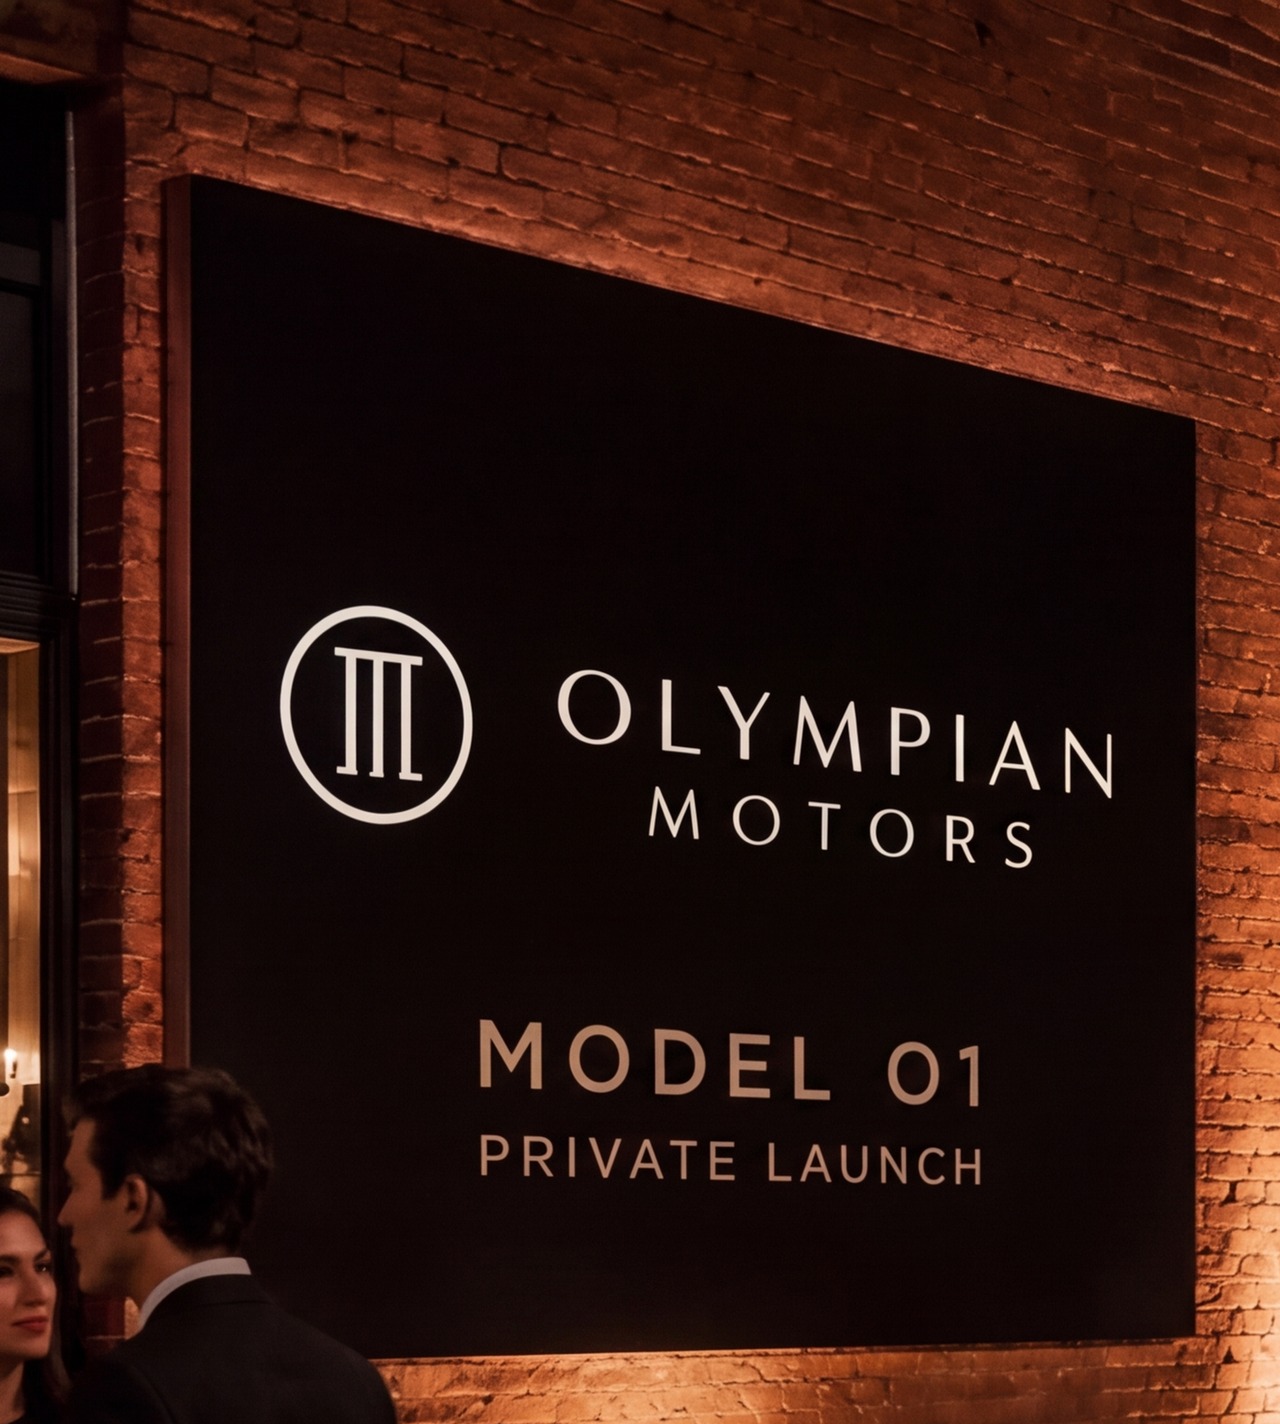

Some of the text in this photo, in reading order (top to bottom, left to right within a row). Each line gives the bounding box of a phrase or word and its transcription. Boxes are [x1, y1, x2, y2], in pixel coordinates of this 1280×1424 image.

[557, 669, 1114, 800] OLYMPIAN
[647, 784, 1036, 870] MOTORS
[479, 1018, 832, 1101] MODEL
[479, 1133, 982, 1187] PRIVATE LAUNCH
